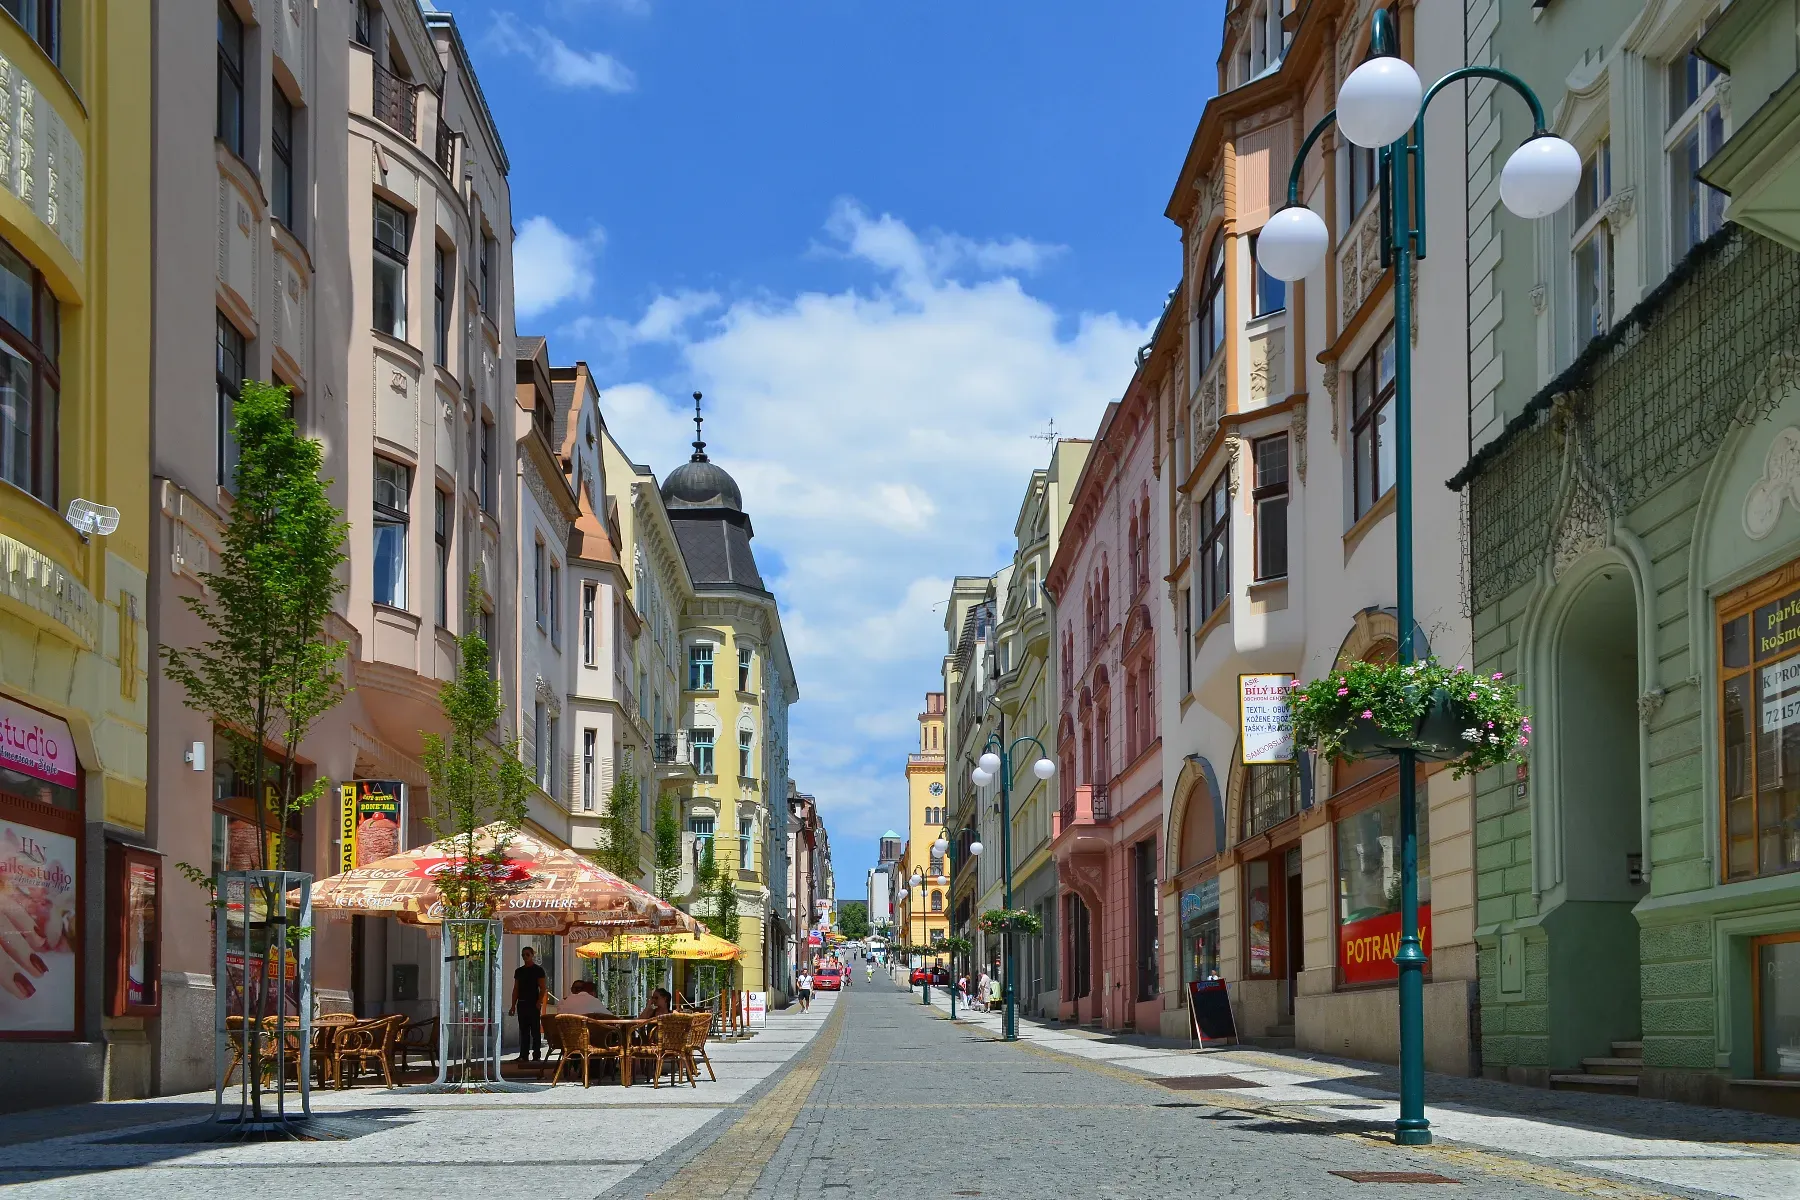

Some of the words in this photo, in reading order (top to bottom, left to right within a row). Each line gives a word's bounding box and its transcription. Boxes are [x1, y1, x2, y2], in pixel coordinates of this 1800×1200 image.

[1245, 685, 1268, 695] BÍLÝ
[1271, 686, 1290, 695] LEV
[1246, 706, 1266, 714] TEXTIL
[1272, 713, 1292, 723] ZBOŽ
[344, 788, 353, 839] HOUSE
[30, 866, 72, 886] studio
[335, 897, 355, 907] ICE
[358, 897, 394, 908] COLD
[509, 898, 541, 909] SOLD
[544, 898, 576, 909] HERE
[1346, 926, 1427, 965] POTRAVY
